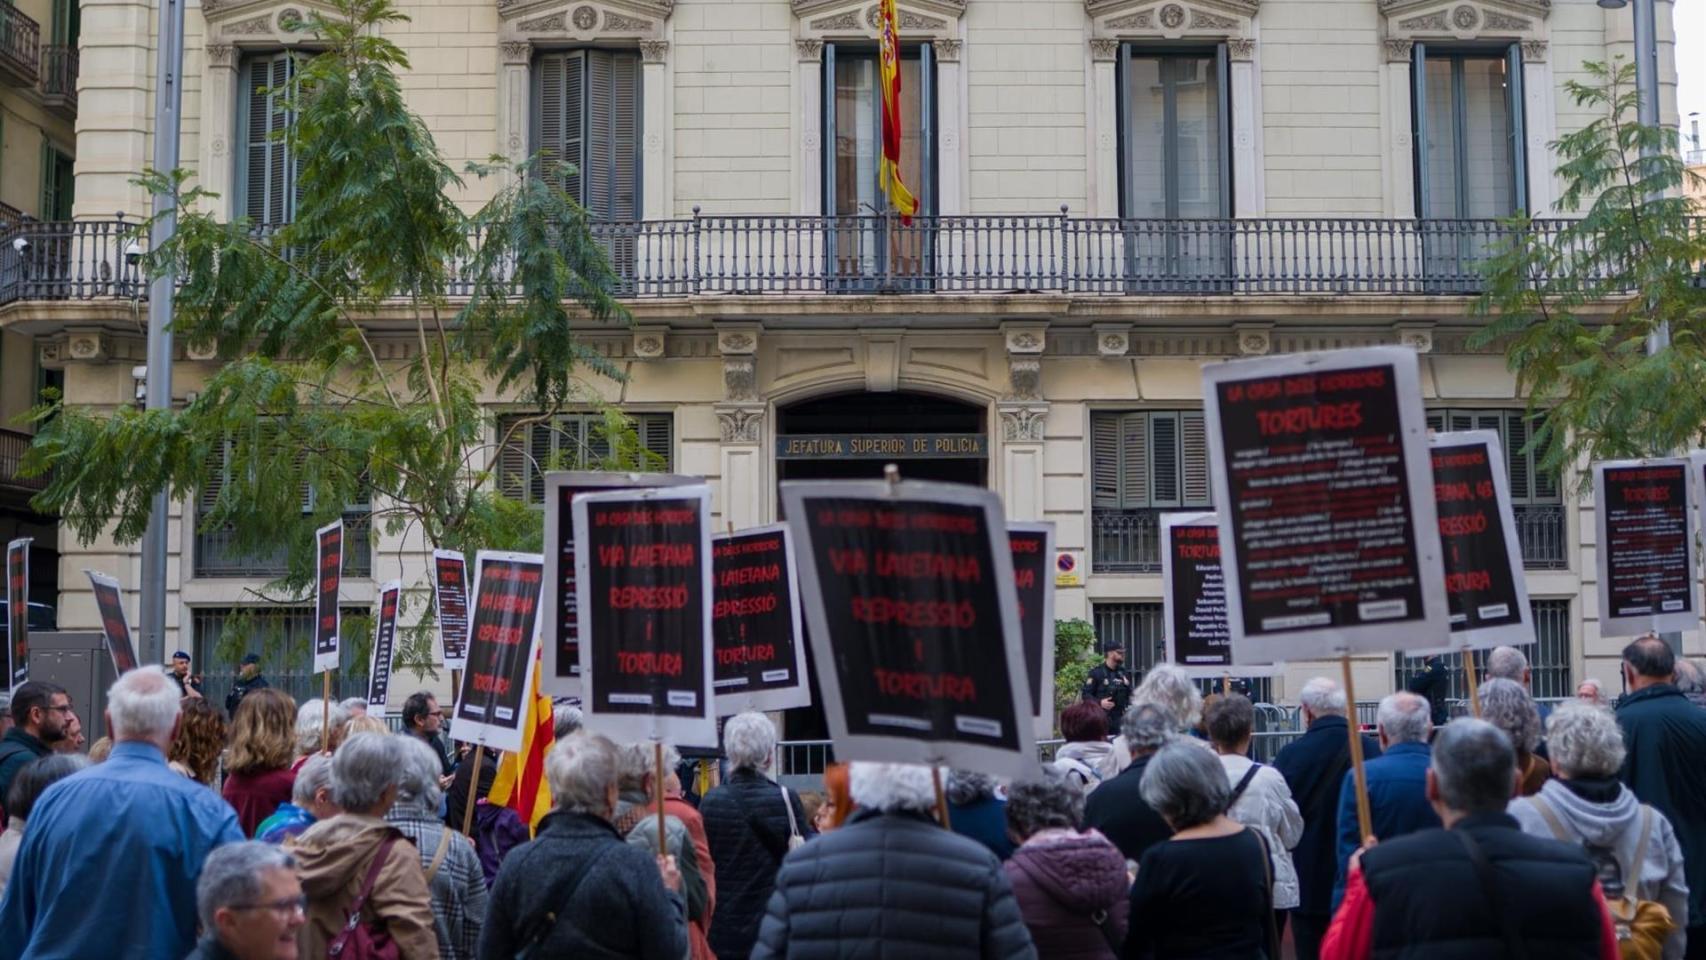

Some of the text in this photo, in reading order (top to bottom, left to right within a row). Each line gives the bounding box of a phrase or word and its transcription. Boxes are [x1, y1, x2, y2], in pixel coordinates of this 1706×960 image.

[1256, 402, 1363, 435] TORTURES
[785, 439, 842, 454] JEFATURA
[851, 439, 905, 453] SUPERIOR
[913, 438, 928, 453] DE
[599, 544, 624, 568] VIA
[630, 543, 694, 568] LAIETANA
[828, 547, 867, 574] VIA
[875, 550, 980, 583] LAIETANA
[1177, 543, 1221, 560] TORTUR
[721, 563, 780, 588] LAIETANA
[1446, 569, 1491, 593] RTURA
[608, 582, 689, 609] REPRESSIÓ
[712, 591, 778, 618] EPRESSIÓ
[853, 596, 977, 629] REPRESSIÓ
[616, 651, 684, 678] TORTURA
[716, 644, 774, 666] TORTURA
[873, 667, 977, 703] TORTURA
